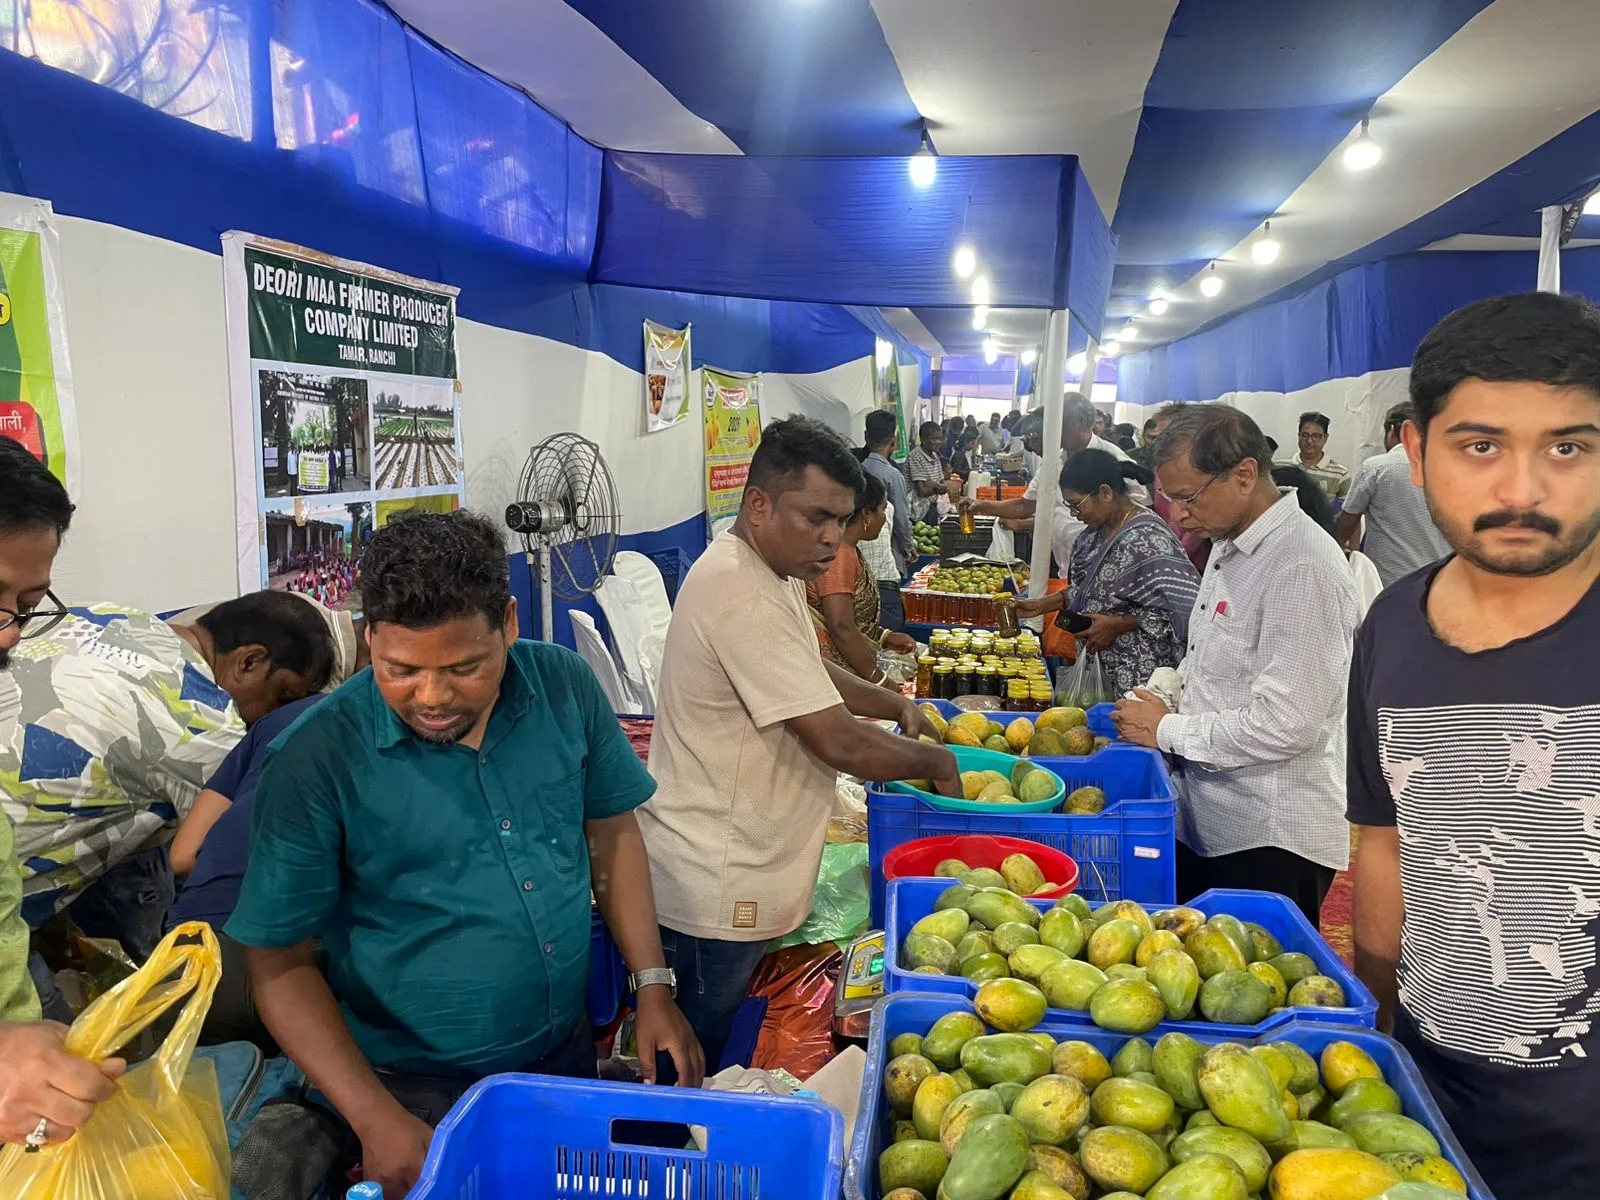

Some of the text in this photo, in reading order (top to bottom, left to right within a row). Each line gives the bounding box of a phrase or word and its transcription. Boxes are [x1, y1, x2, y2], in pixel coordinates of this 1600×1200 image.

[254, 262, 448, 326] DEORI MAA FARMER PRODUCER
[304, 307, 418, 348] COMPANY LIMITED
[369, 348, 396, 366] RANCHI
